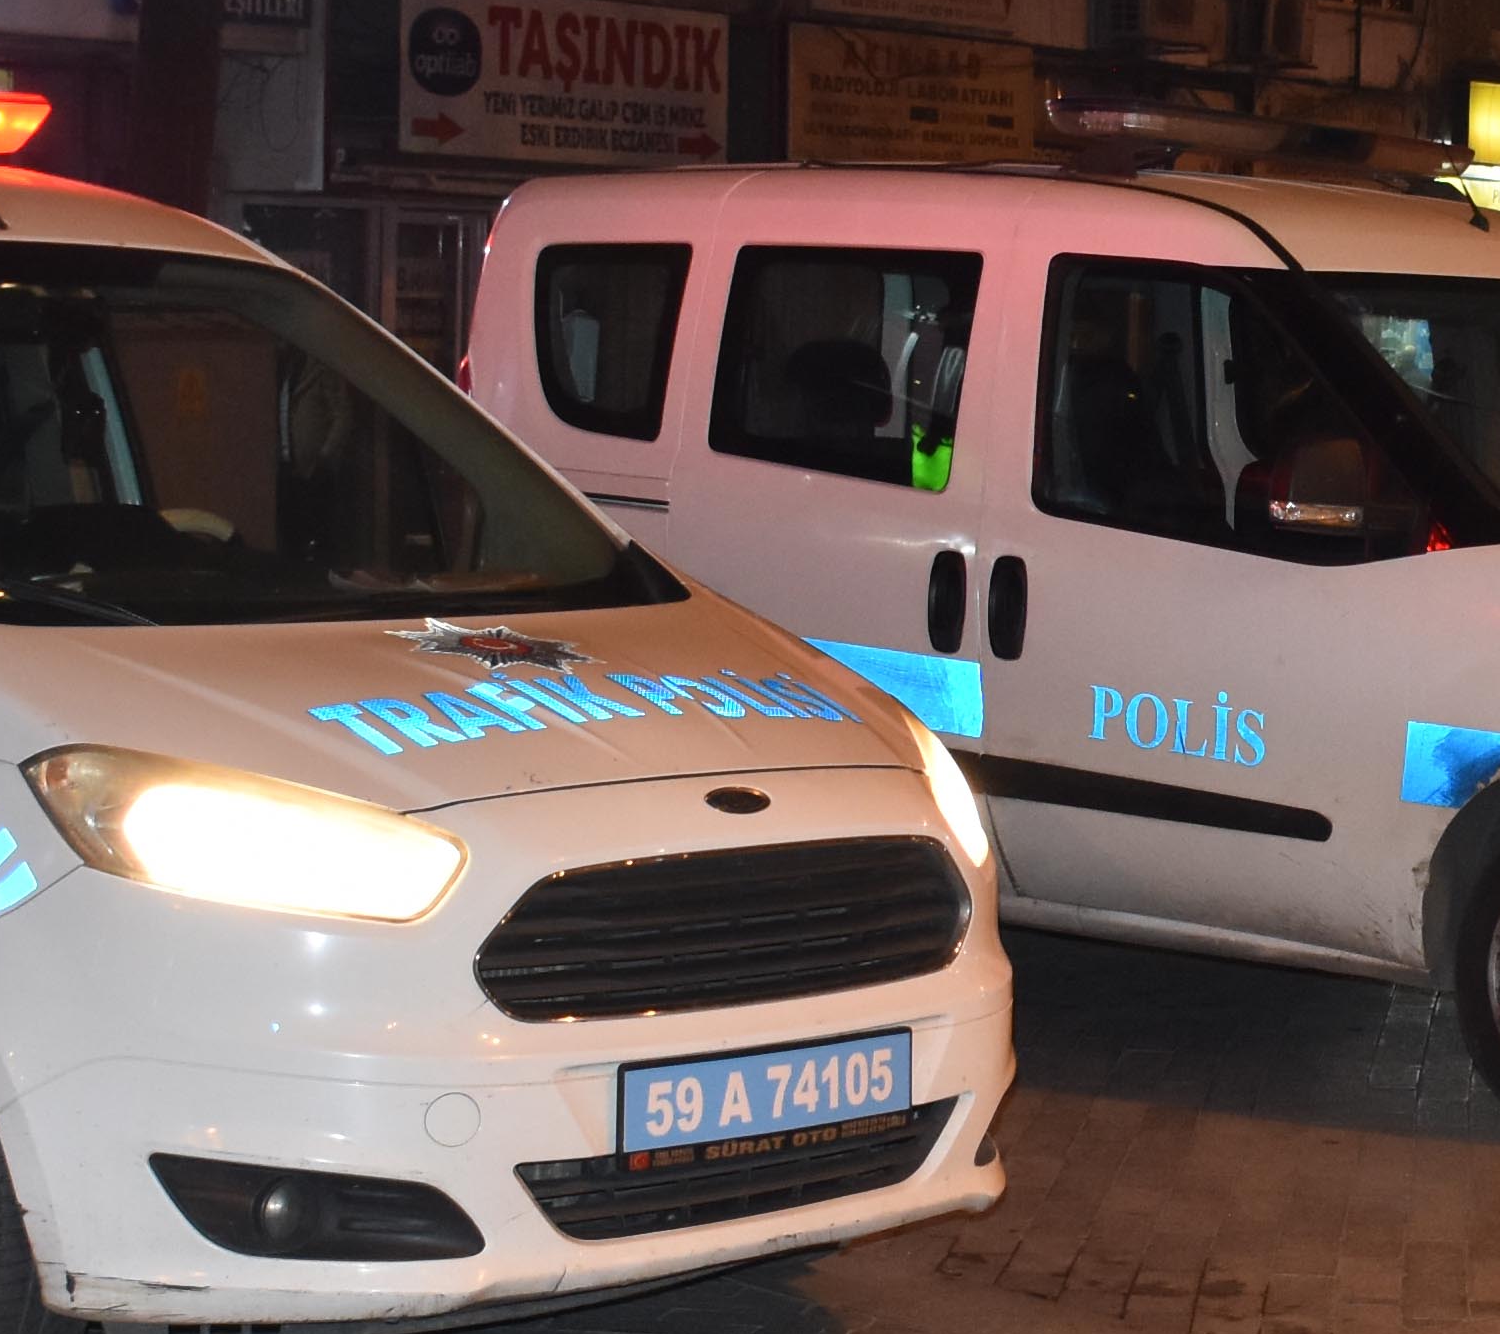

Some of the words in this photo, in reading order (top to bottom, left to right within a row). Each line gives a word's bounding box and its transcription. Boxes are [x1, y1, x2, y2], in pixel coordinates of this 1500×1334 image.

[487, 4, 722, 95] TAŞINDIK
[308, 671, 639, 756] TRAFİK
[613, 666, 863, 725] POLİSİ
[1086, 682, 1267, 768] POLİS
[644, 1077, 704, 1139] 59
[718, 1069, 771, 1127] A
[771, 1049, 894, 1118] 74105
[703, 1134, 787, 1161] SÜRAT
[791, 1126, 838, 1147] OTO
